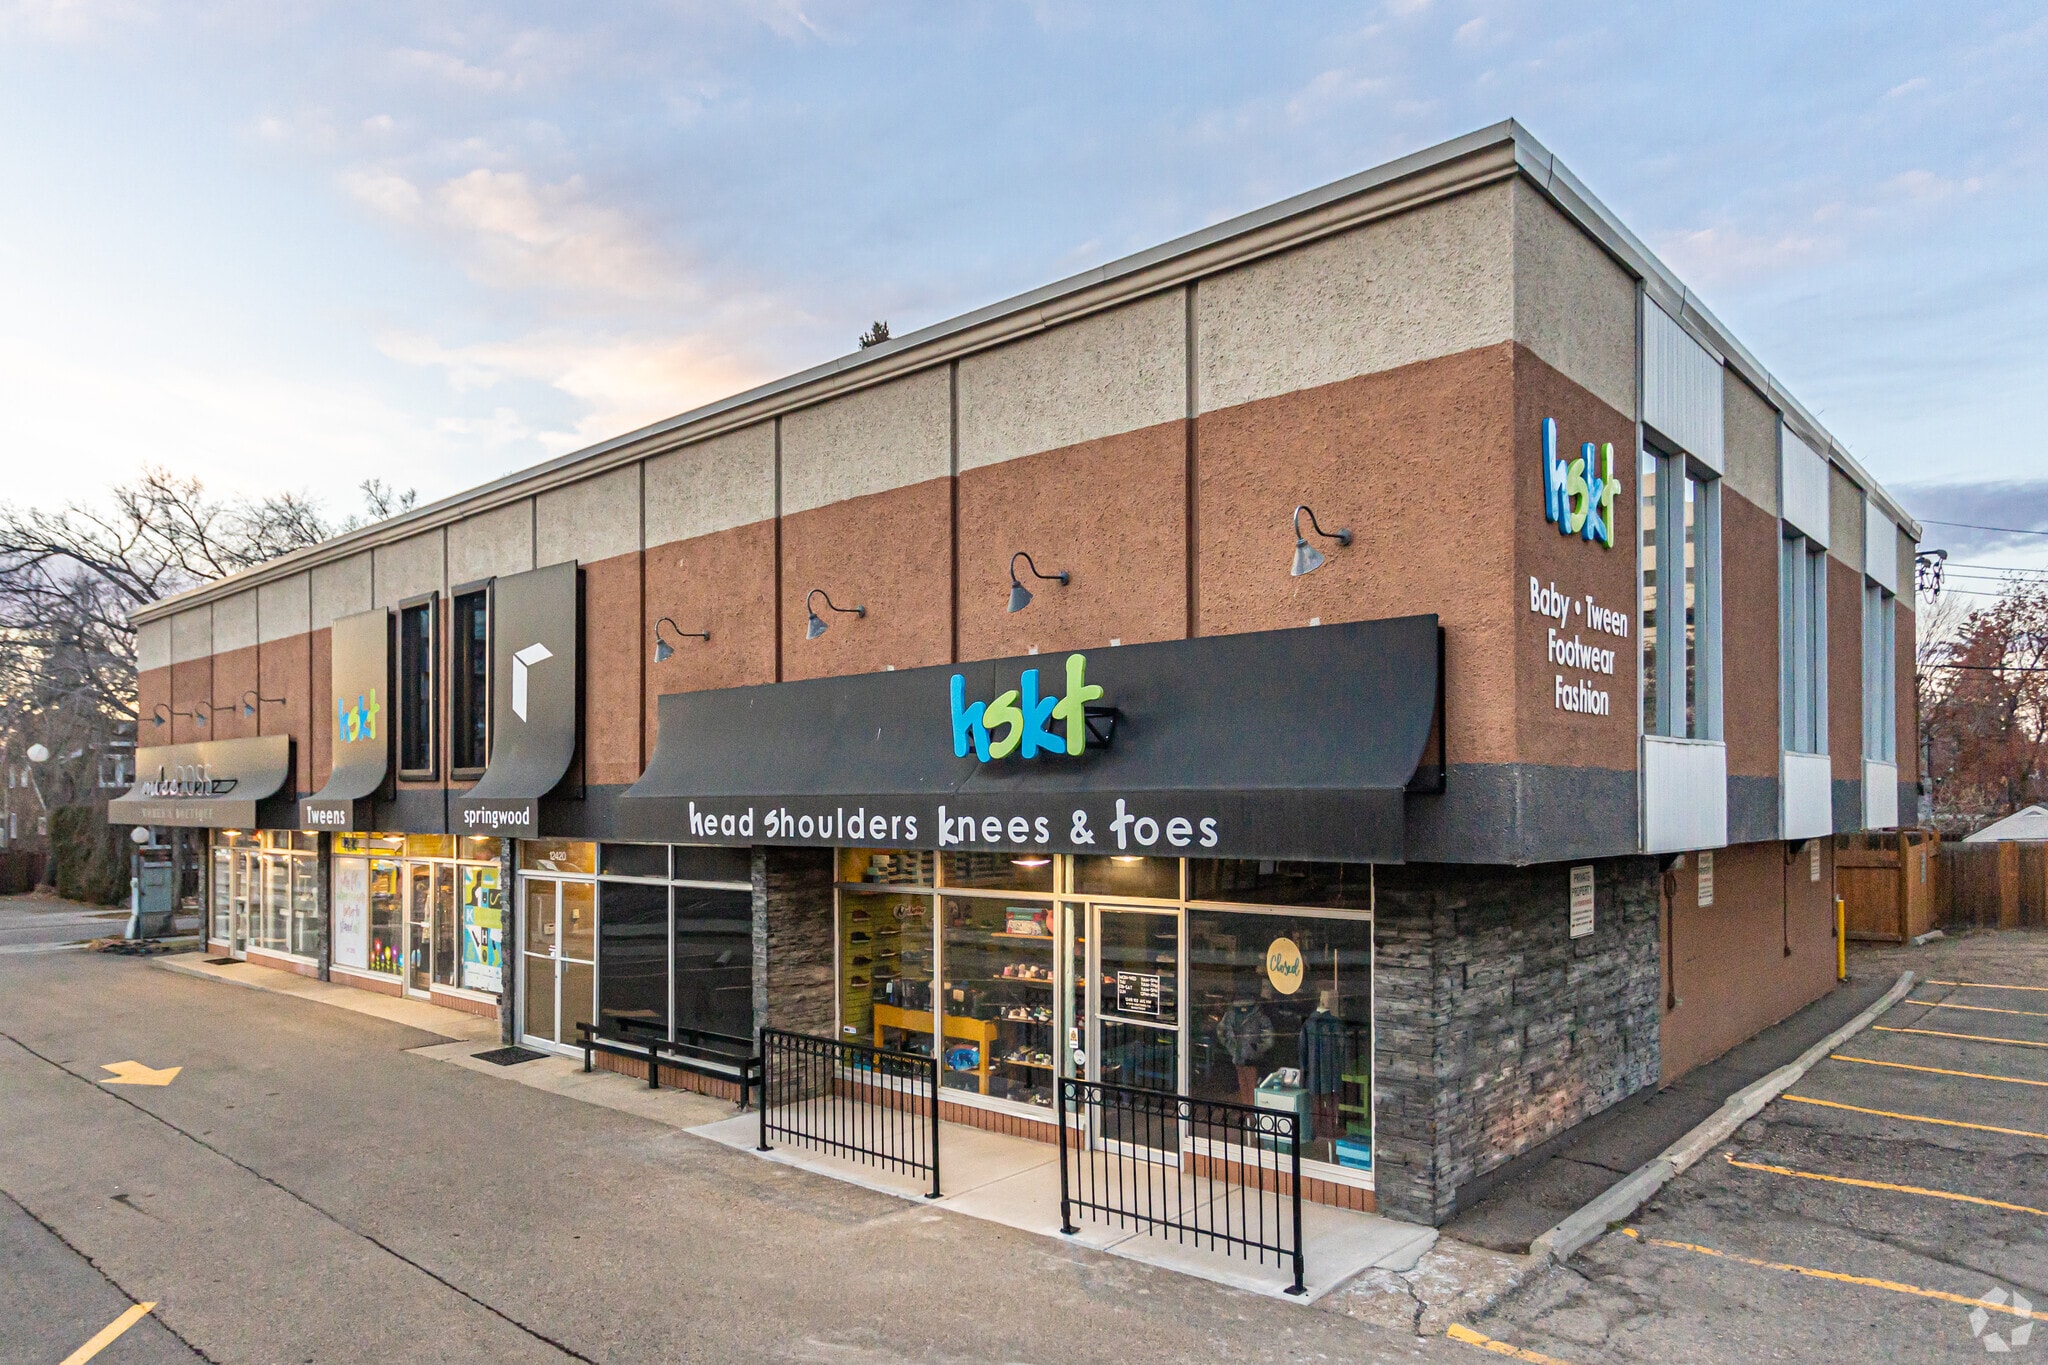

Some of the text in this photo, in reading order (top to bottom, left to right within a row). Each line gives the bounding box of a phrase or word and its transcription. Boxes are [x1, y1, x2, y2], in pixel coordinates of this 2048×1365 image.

[1541, 417, 1622, 549] hskt
[1529, 576, 1629, 638] Baby Tween
[1547, 627, 1616, 676] Footwear
[949, 653, 1105, 764] hskt
[1554, 674, 1610, 716] Fashion
[305, 804, 347, 826] Tweens
[462, 805, 531, 829] springwood
[688, 798, 1219, 850] head shoulders knees & toes
[549, 851, 567, 861] 12420
[1269, 953, 1300, 977] Closed
